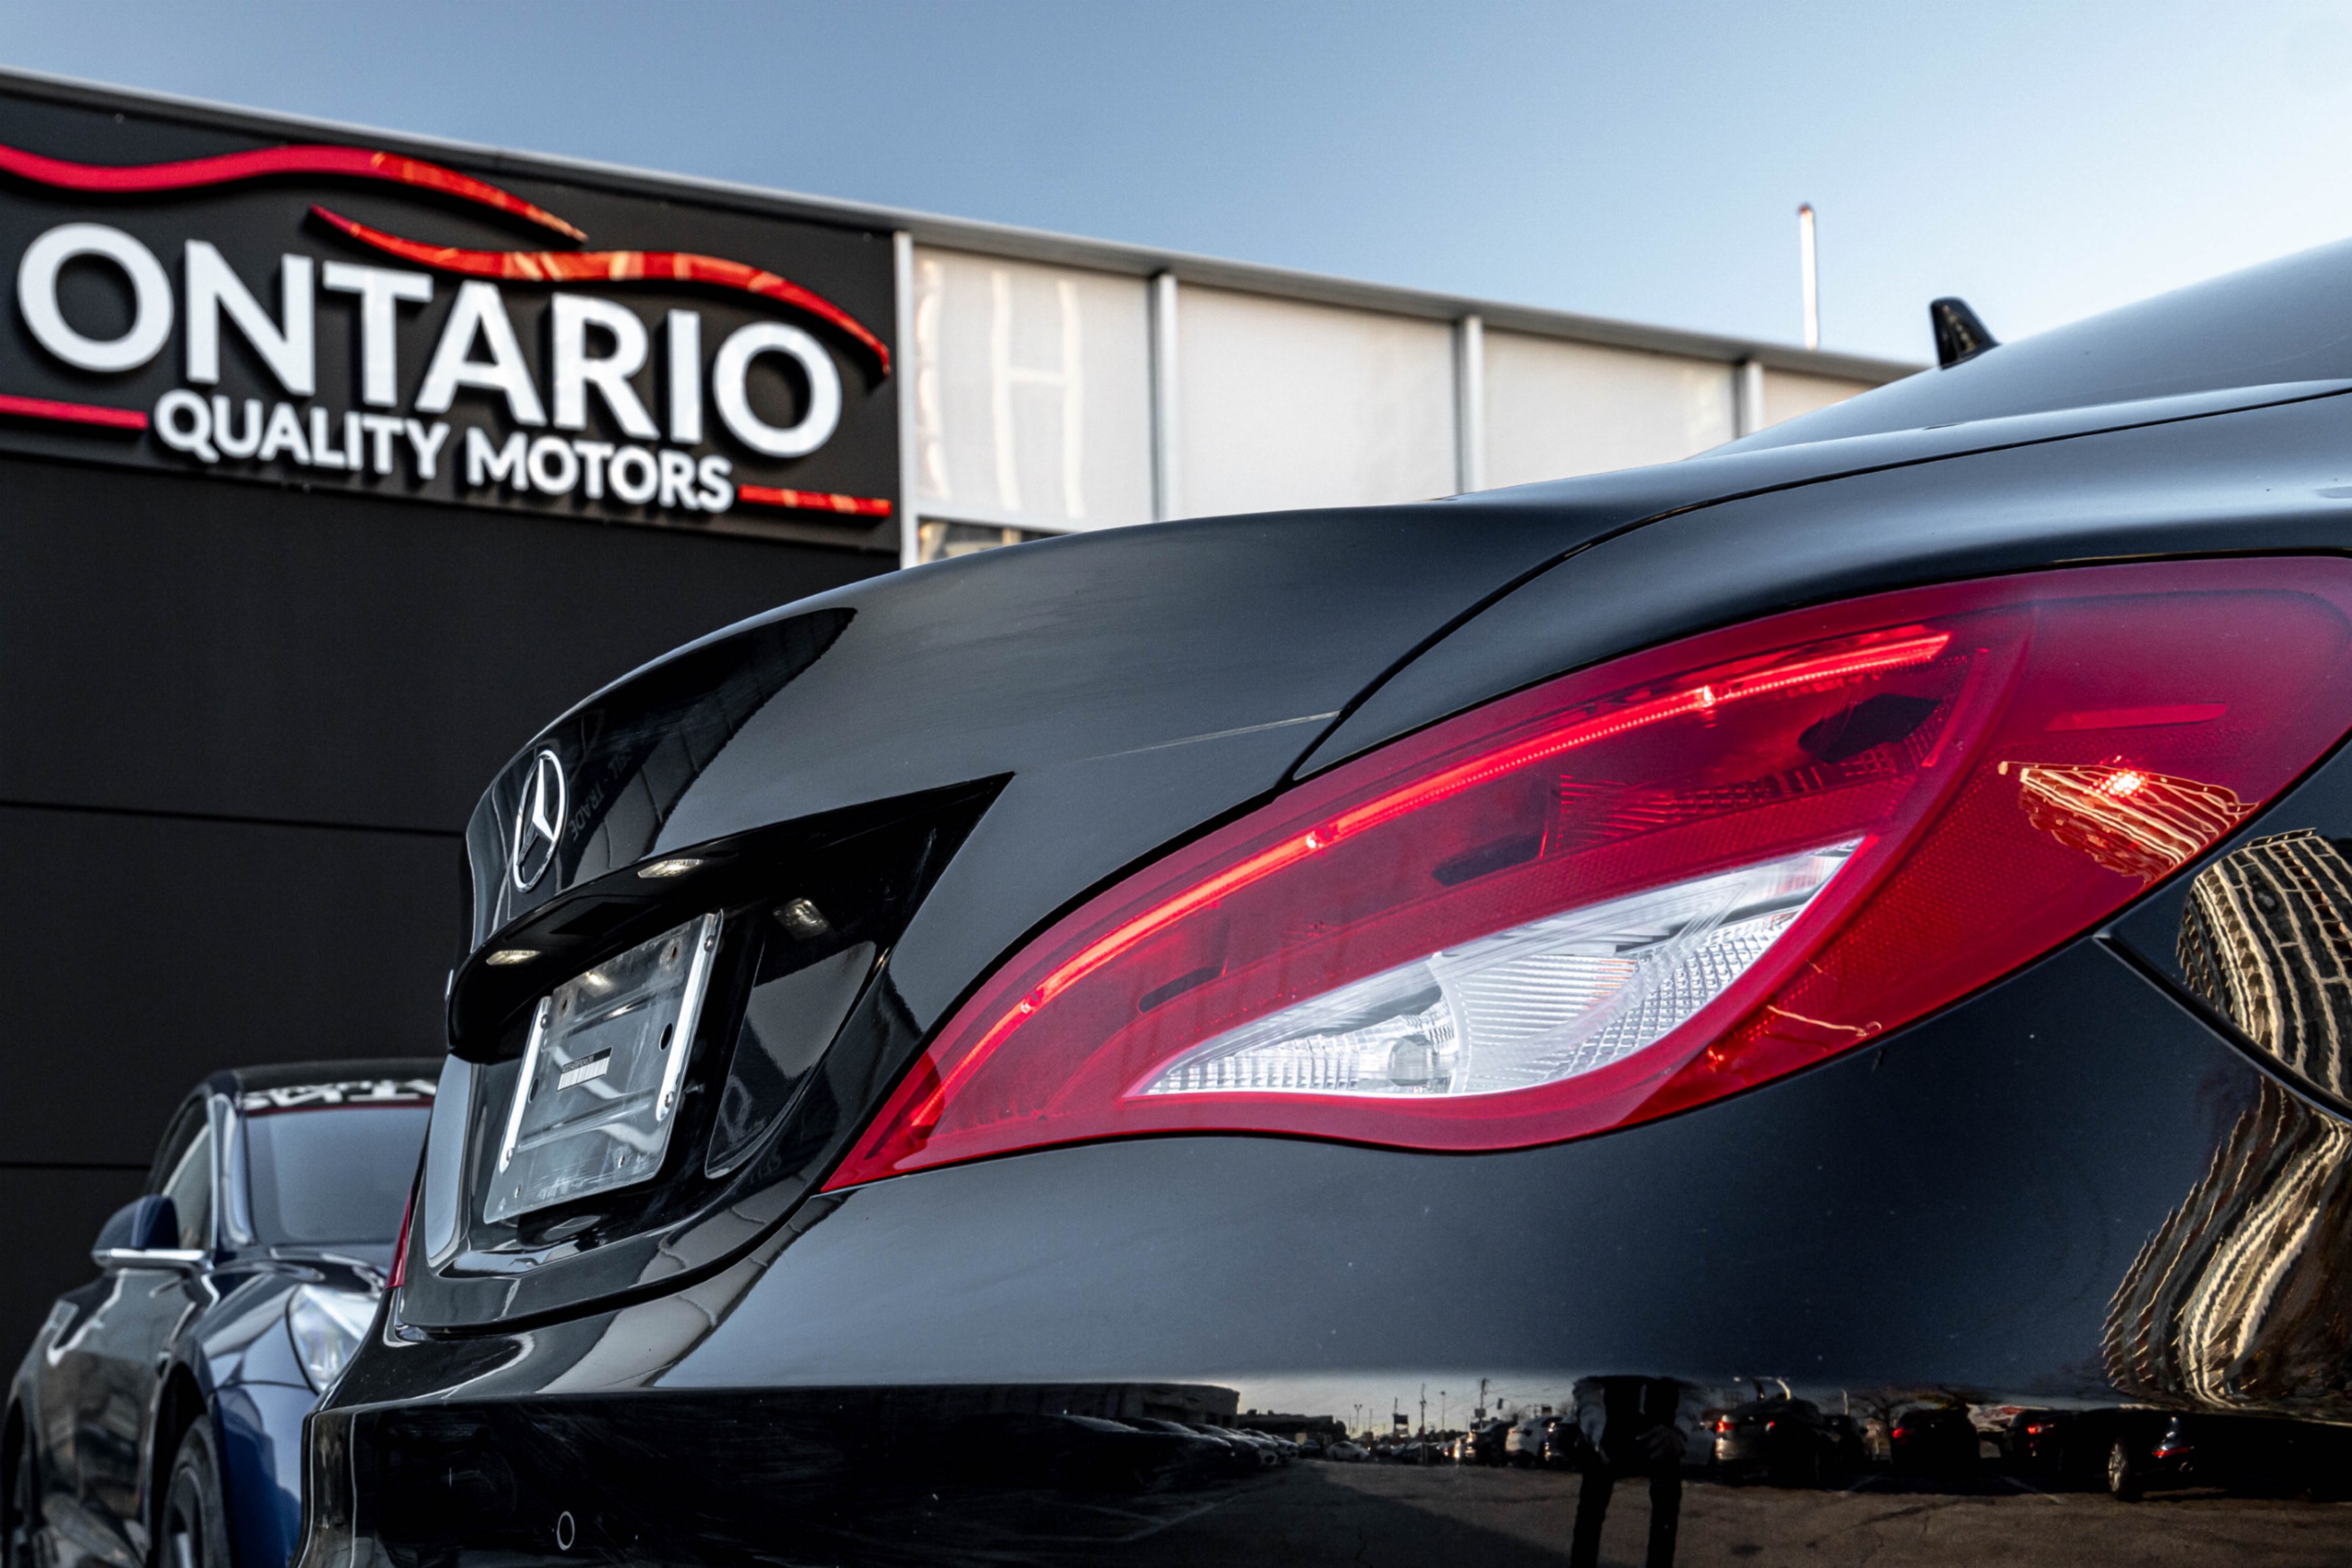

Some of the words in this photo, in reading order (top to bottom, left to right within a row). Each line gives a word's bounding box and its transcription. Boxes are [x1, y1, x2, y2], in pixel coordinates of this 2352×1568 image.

[18, 222, 841, 457] ONTARIO
[155, 389, 450, 479] QUALITY
[466, 427, 733, 513] MOTORS
